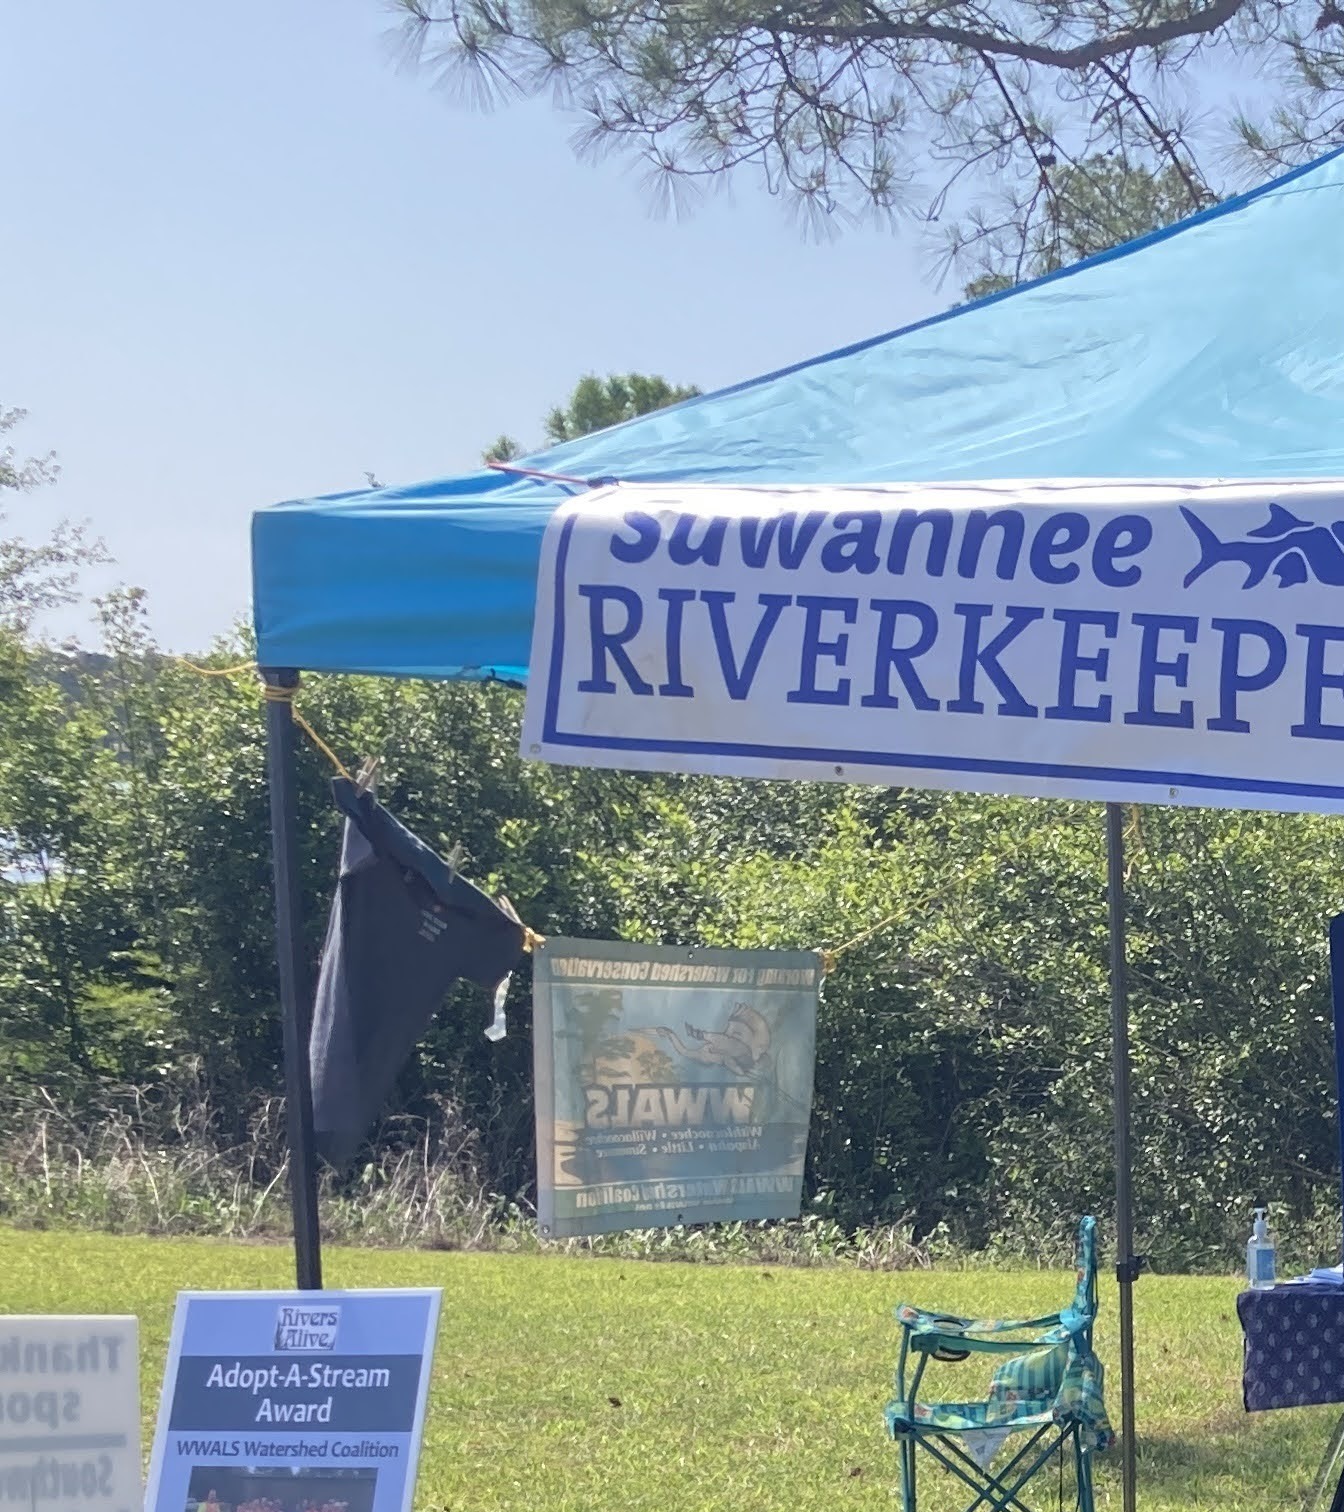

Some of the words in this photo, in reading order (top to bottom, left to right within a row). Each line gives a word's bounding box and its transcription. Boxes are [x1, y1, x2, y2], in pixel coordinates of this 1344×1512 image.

[281, 1308, 338, 1327] Rivers
[283, 1329, 330, 1348] Alive
[206, 1362, 390, 1395] Adopt-A-Stream
[255, 1396, 333, 1423] Award
[177, 1440, 240, 1457] WWALS
[244, 1440, 329, 1457] Watershed
[331, 1440, 400, 1458] Coalition
